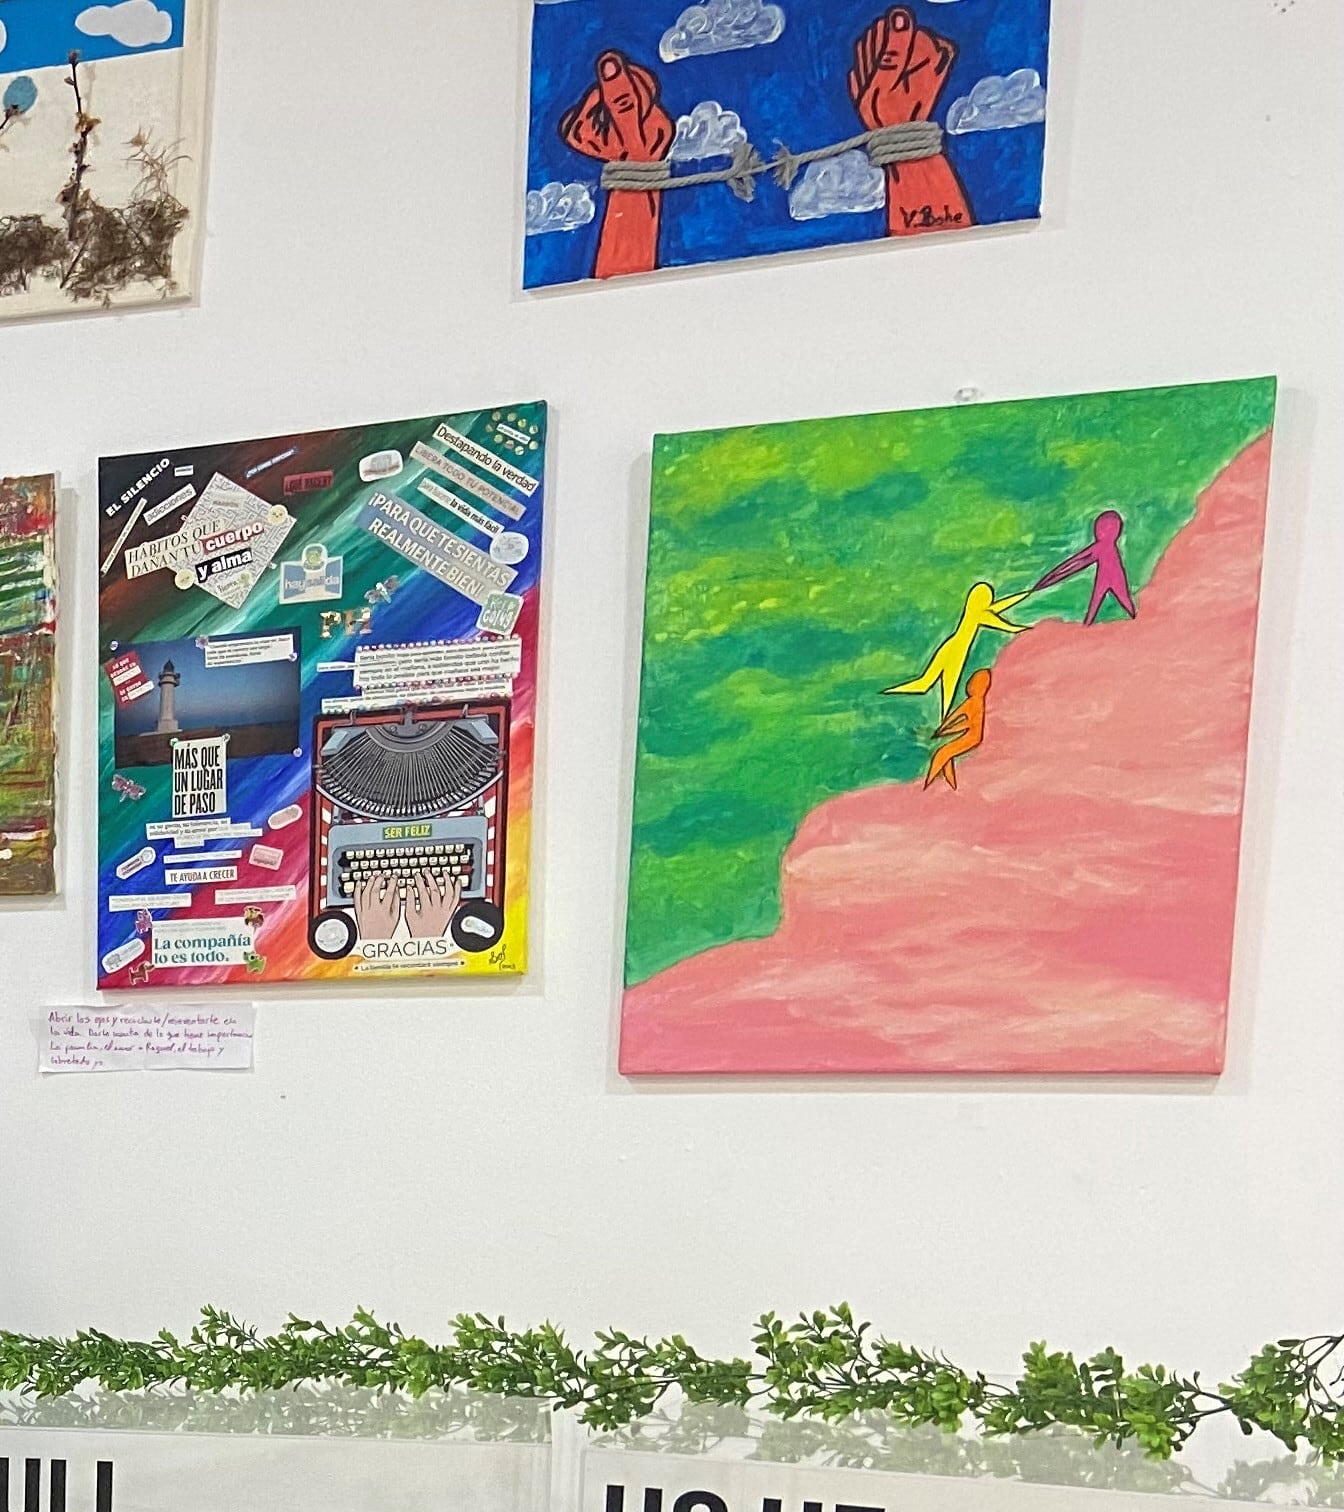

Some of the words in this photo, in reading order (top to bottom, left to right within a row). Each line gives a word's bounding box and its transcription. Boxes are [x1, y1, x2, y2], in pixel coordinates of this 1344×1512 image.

[437, 426, 492, 467] Destapando
[502, 466, 537, 493] verdad
[105, 502, 122, 517] EL
[122, 458, 170, 505] SILENCIO
[206, 522, 264, 551] cuerpo
[212, 550, 253, 572] alma
[368, 517, 450, 576] REALMENTE
[447, 566, 484, 598] BIEN!
[409, 516, 440, 545] QUE
[452, 544, 510, 587] SIENTAS
[174, 743, 198, 771] MÁS
[201, 745, 221, 770] QUE
[174, 771, 188, 793] UN
[190, 768, 224, 792] LUGAR
[174, 795, 187, 816] DE
[189, 792, 216, 814] PASO
[384, 827, 403, 838] SER
[405, 824, 431, 837] FELIZ
[170, 873, 178, 883] TE
[209, 868, 235, 880] CRECER
[154, 938, 170, 950] La
[174, 934, 251, 951] compañía
[154, 953, 167, 964] lo
[172, 954, 187, 963] es
[191, 951, 230, 962] todo.
